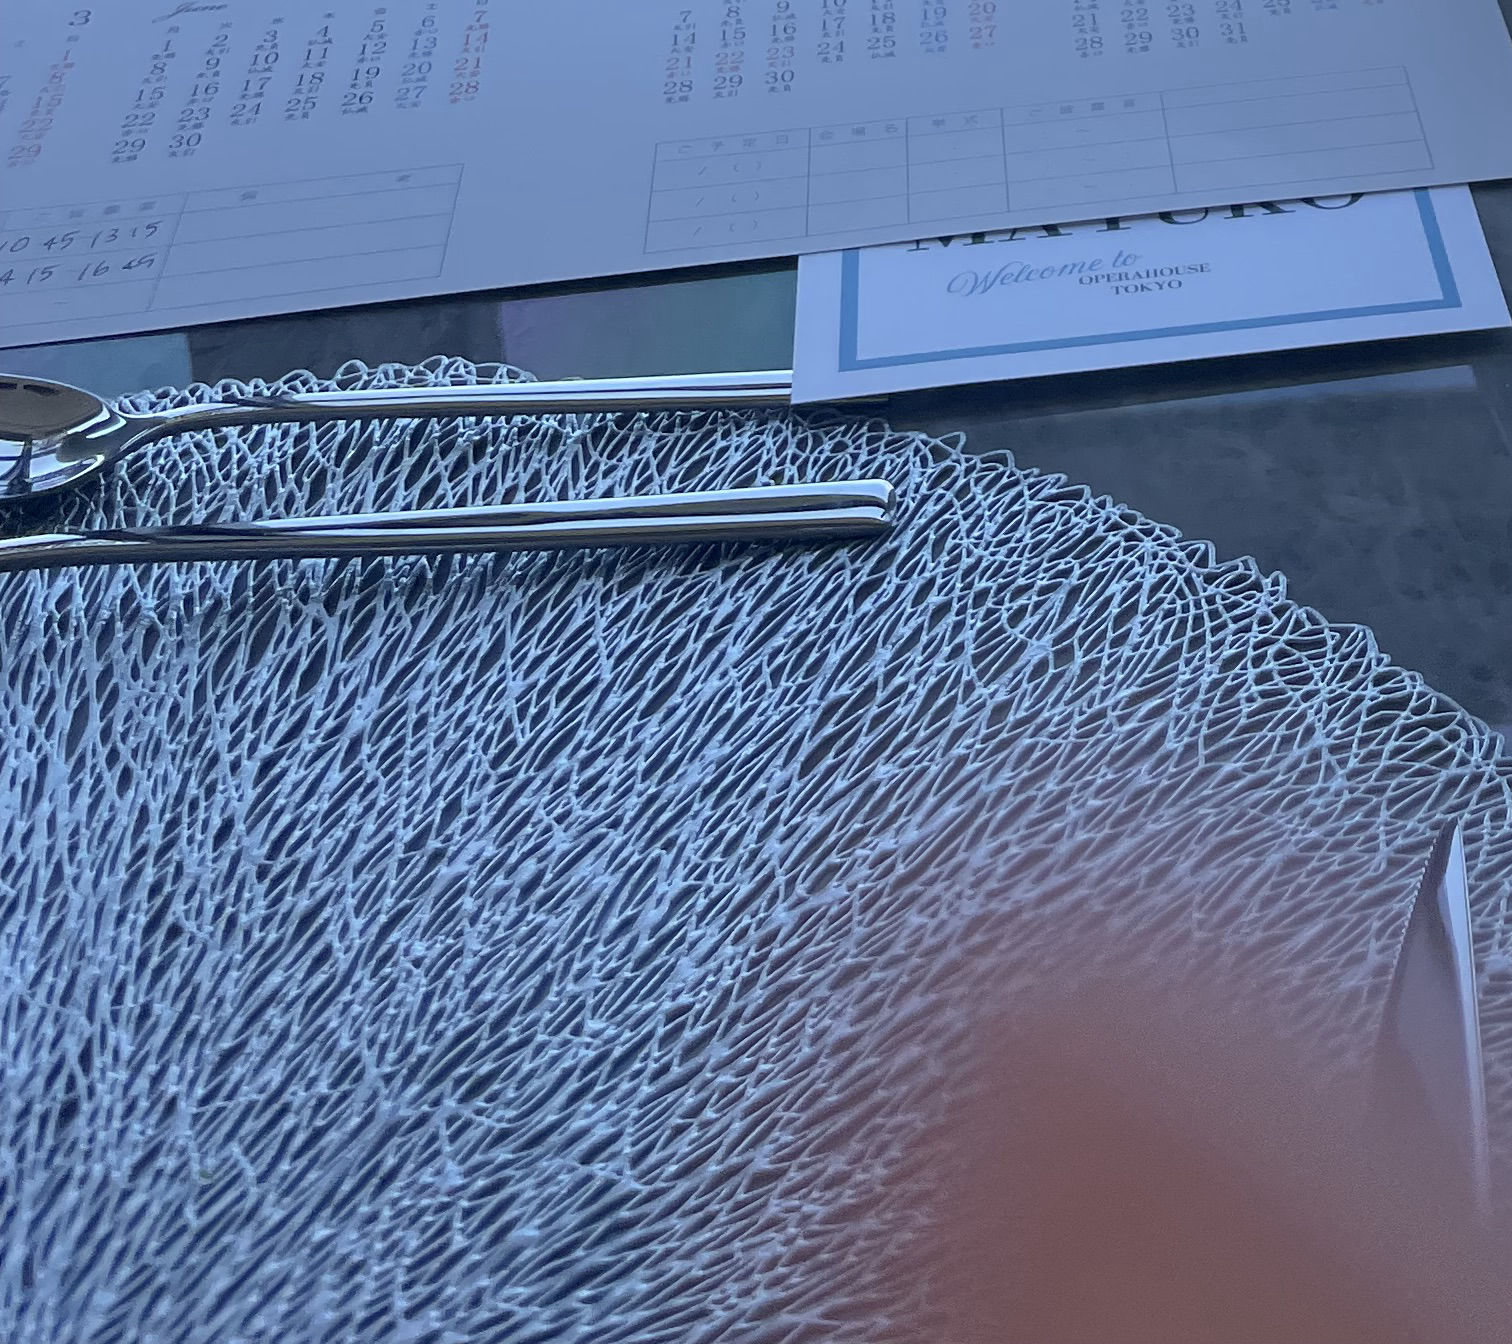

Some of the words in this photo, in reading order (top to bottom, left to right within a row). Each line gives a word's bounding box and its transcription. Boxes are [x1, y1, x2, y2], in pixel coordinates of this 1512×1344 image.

[68, 10, 92, 26] 3
[947, 258, 1103, 296] Welcome
[1112, 250, 1143, 268] to
[1079, 262, 1211, 285] OPERAHOUSE
[1110, 279, 1183, 295] TOKYO
